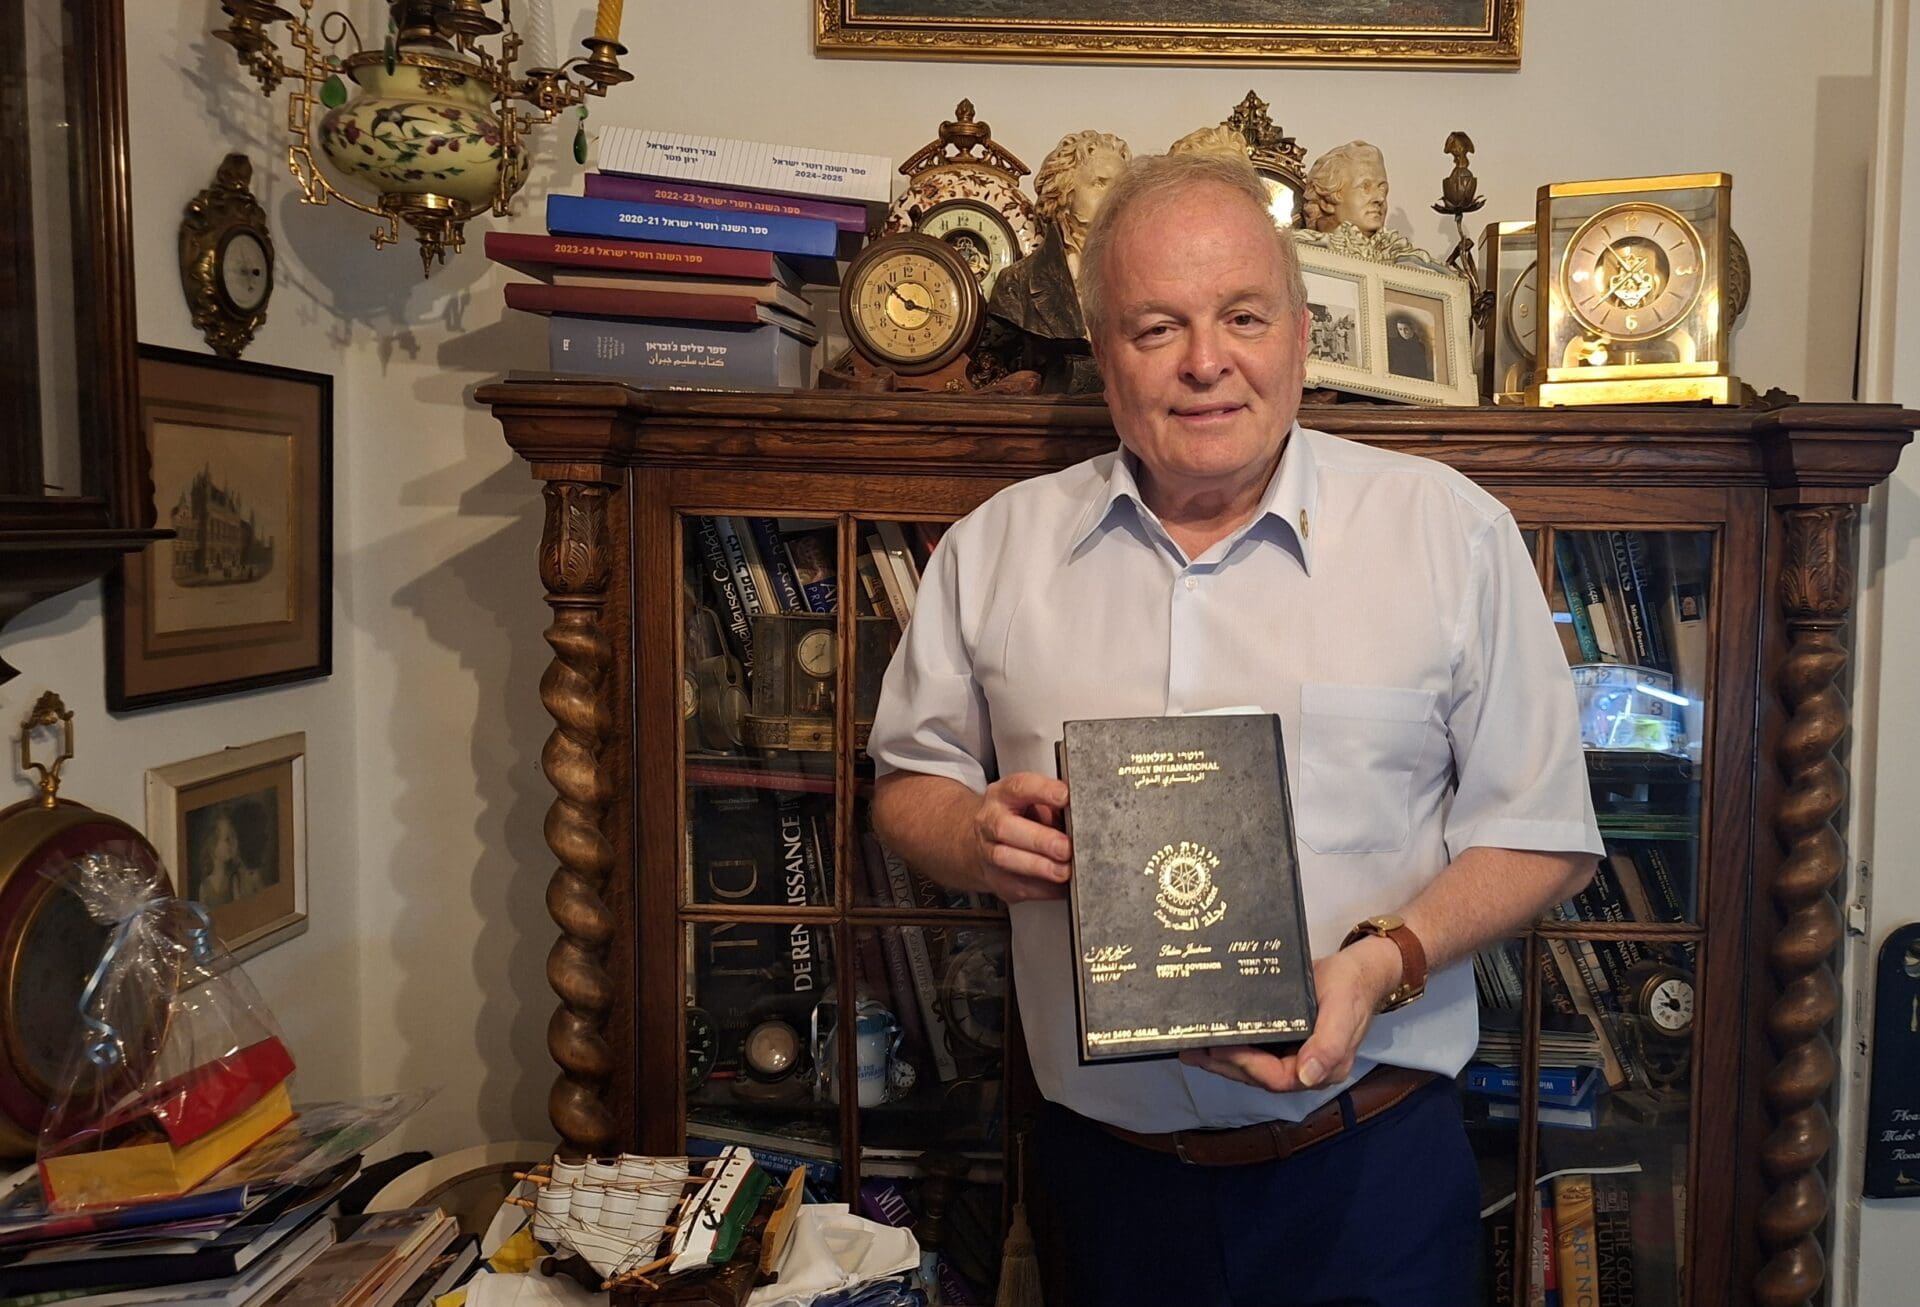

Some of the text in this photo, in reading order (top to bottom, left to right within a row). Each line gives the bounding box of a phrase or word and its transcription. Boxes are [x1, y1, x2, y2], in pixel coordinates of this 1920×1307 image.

[646, 141, 717, 157] נגיד רוטרי ישראל
[772, 156, 866, 177] ספר השנה רוטרי ישראל
[795, 170, 843, 183] 2024-2025
[655, 189, 801, 215] ספר השנה רוטרי ישראל 2022-23
[618, 213, 769, 235] ספר השנה רוטרי ישראל 2020-21
[1624, 216, 1638, 232] 12
[554, 243, 703, 263] ספר השנה רוטרי ישראל 2023-24
[888, 271, 897, 283] 11
[902, 265, 914, 278] 12
[1625, 316, 1637, 330] 6
[680, 342, 704, 353] סלים
[706, 344, 727, 355] ספר
[648, 352, 725, 367] كتاب سليم جبران
[1651, 701, 1664, 716] 3
[1130, 750, 1205, 764] רוטרי בינלאומי
[1118, 761, 1220, 776] ROTARY INTERNATIONAL
[781, 815, 810, 960] RENISSANCE
[1879, 1128, 1916, 1142] Make
[1614, 1218, 1632, 1250] THE
[1572, 1226, 1590, 1271] ART
